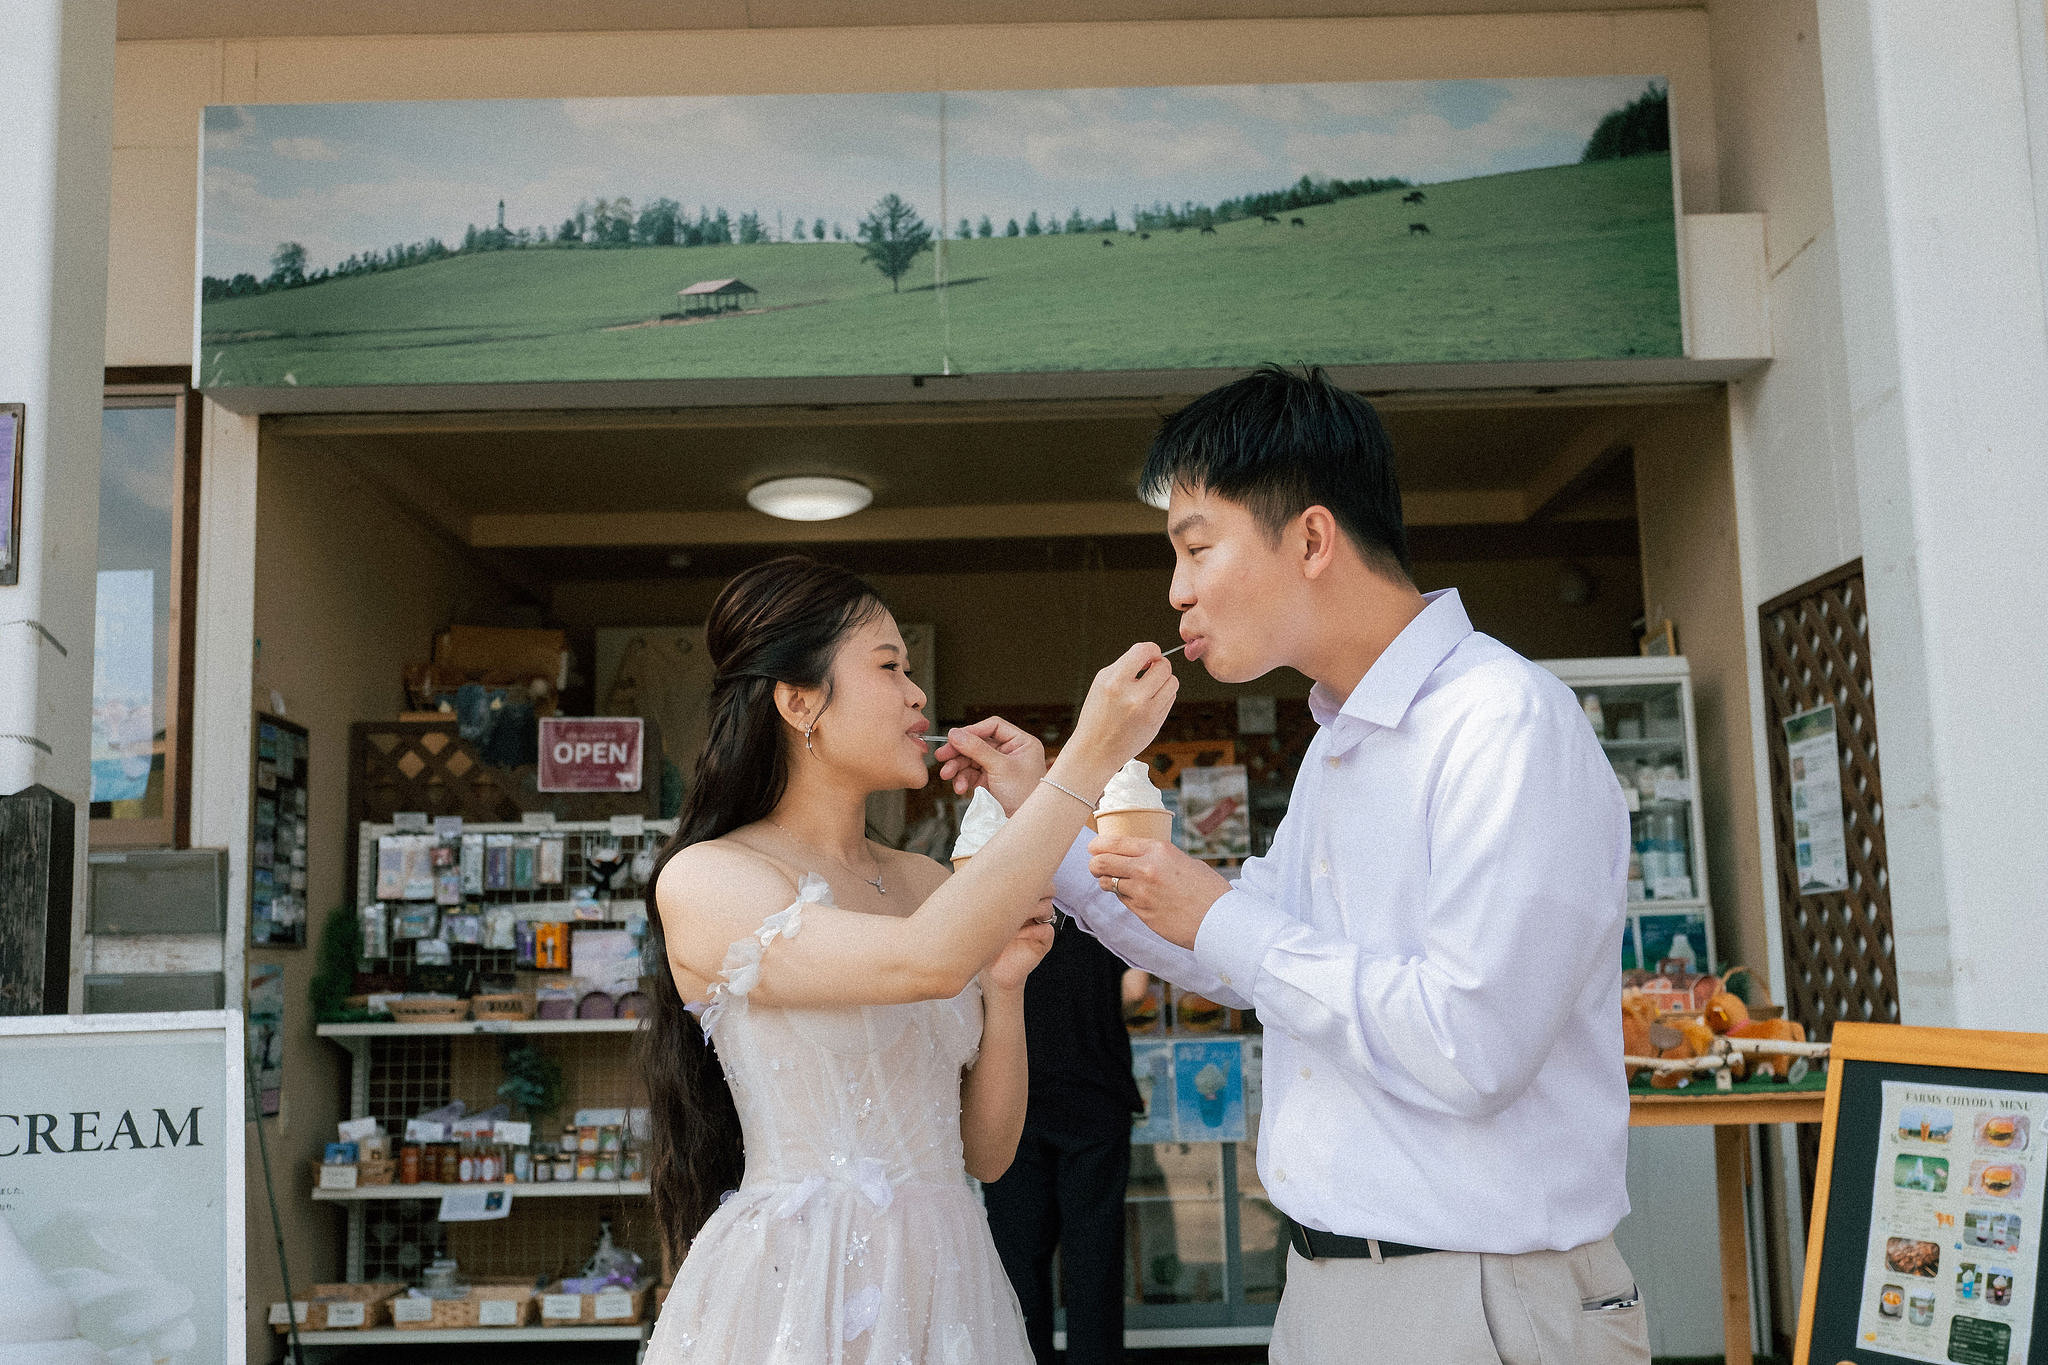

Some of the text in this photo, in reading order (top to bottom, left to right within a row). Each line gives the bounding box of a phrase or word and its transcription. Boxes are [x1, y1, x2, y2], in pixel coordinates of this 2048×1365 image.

[553, 741, 628, 765] OPEN
[1905, 1091, 2032, 1112] FARMS CHIYODA MENU
